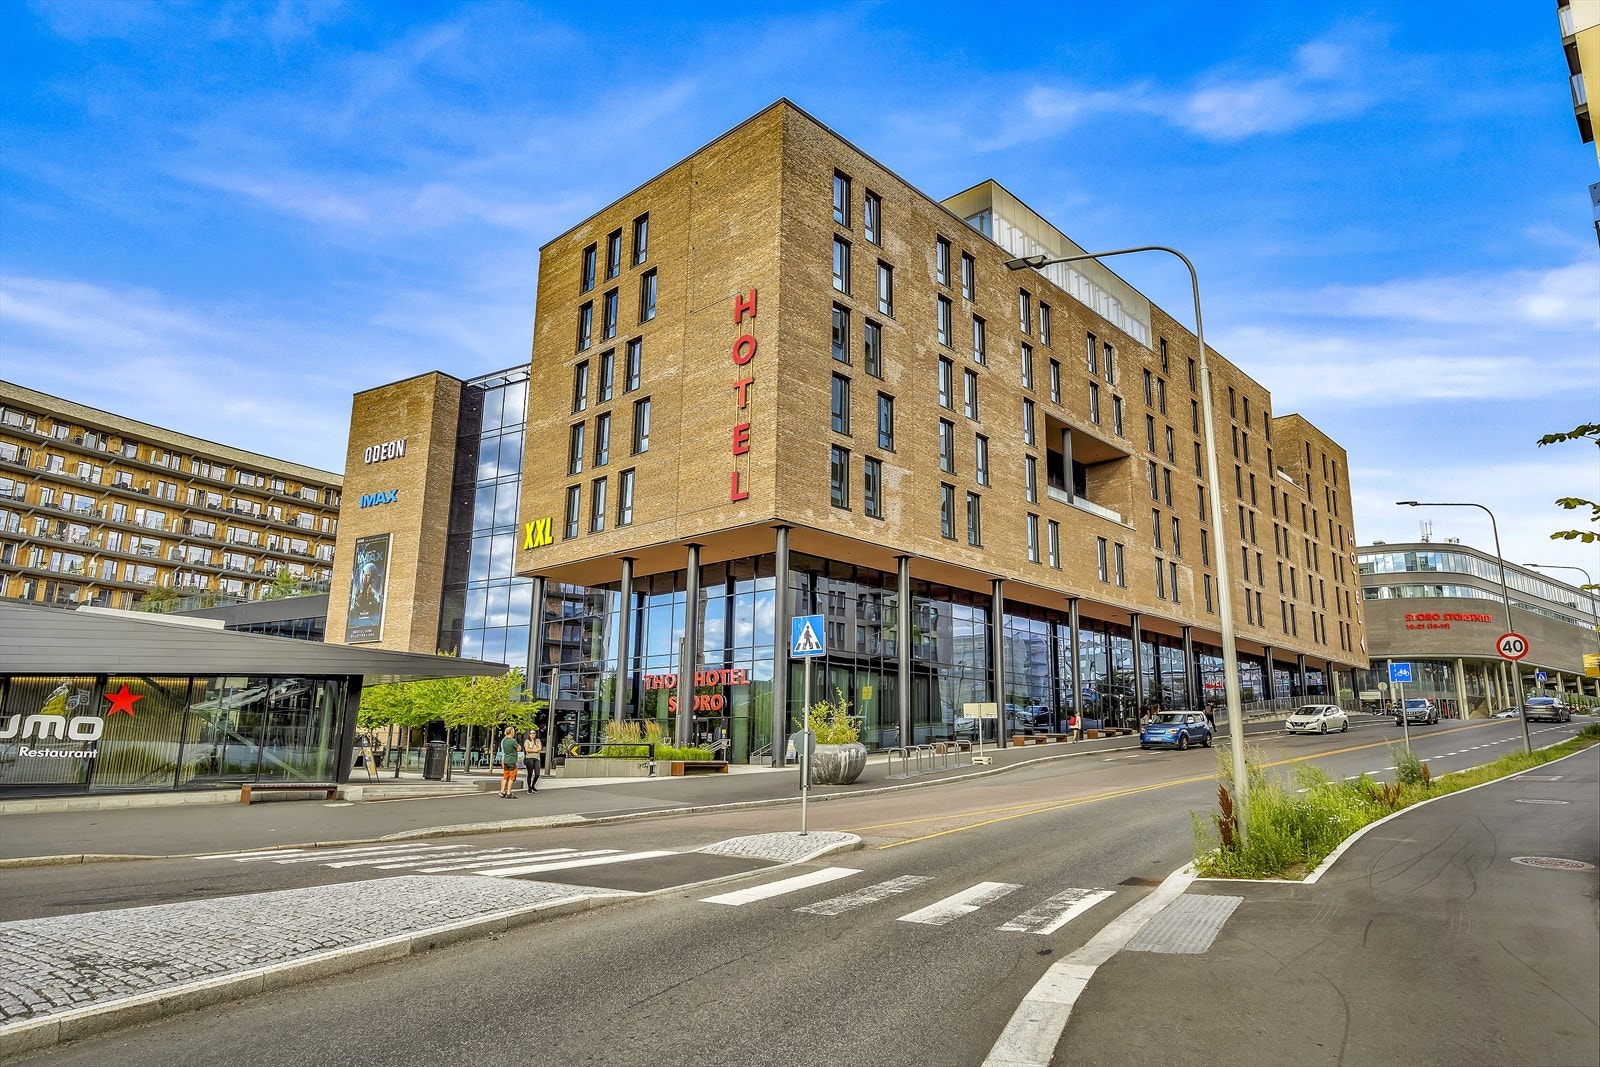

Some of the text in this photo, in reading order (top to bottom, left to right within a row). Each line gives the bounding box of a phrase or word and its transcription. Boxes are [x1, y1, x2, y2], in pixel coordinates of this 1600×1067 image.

[729, 288, 757, 502] HOTEL
[364, 438, 407, 464] ODEON
[359, 489, 398, 508] IMAX
[523, 516, 554, 551] XXL
[1442, 613, 1493, 623] STORSENTER
[1502, 640, 1524, 653] 40
[694, 668, 751, 687] HOTEL
[19, 746, 98, 758] Restaurant
